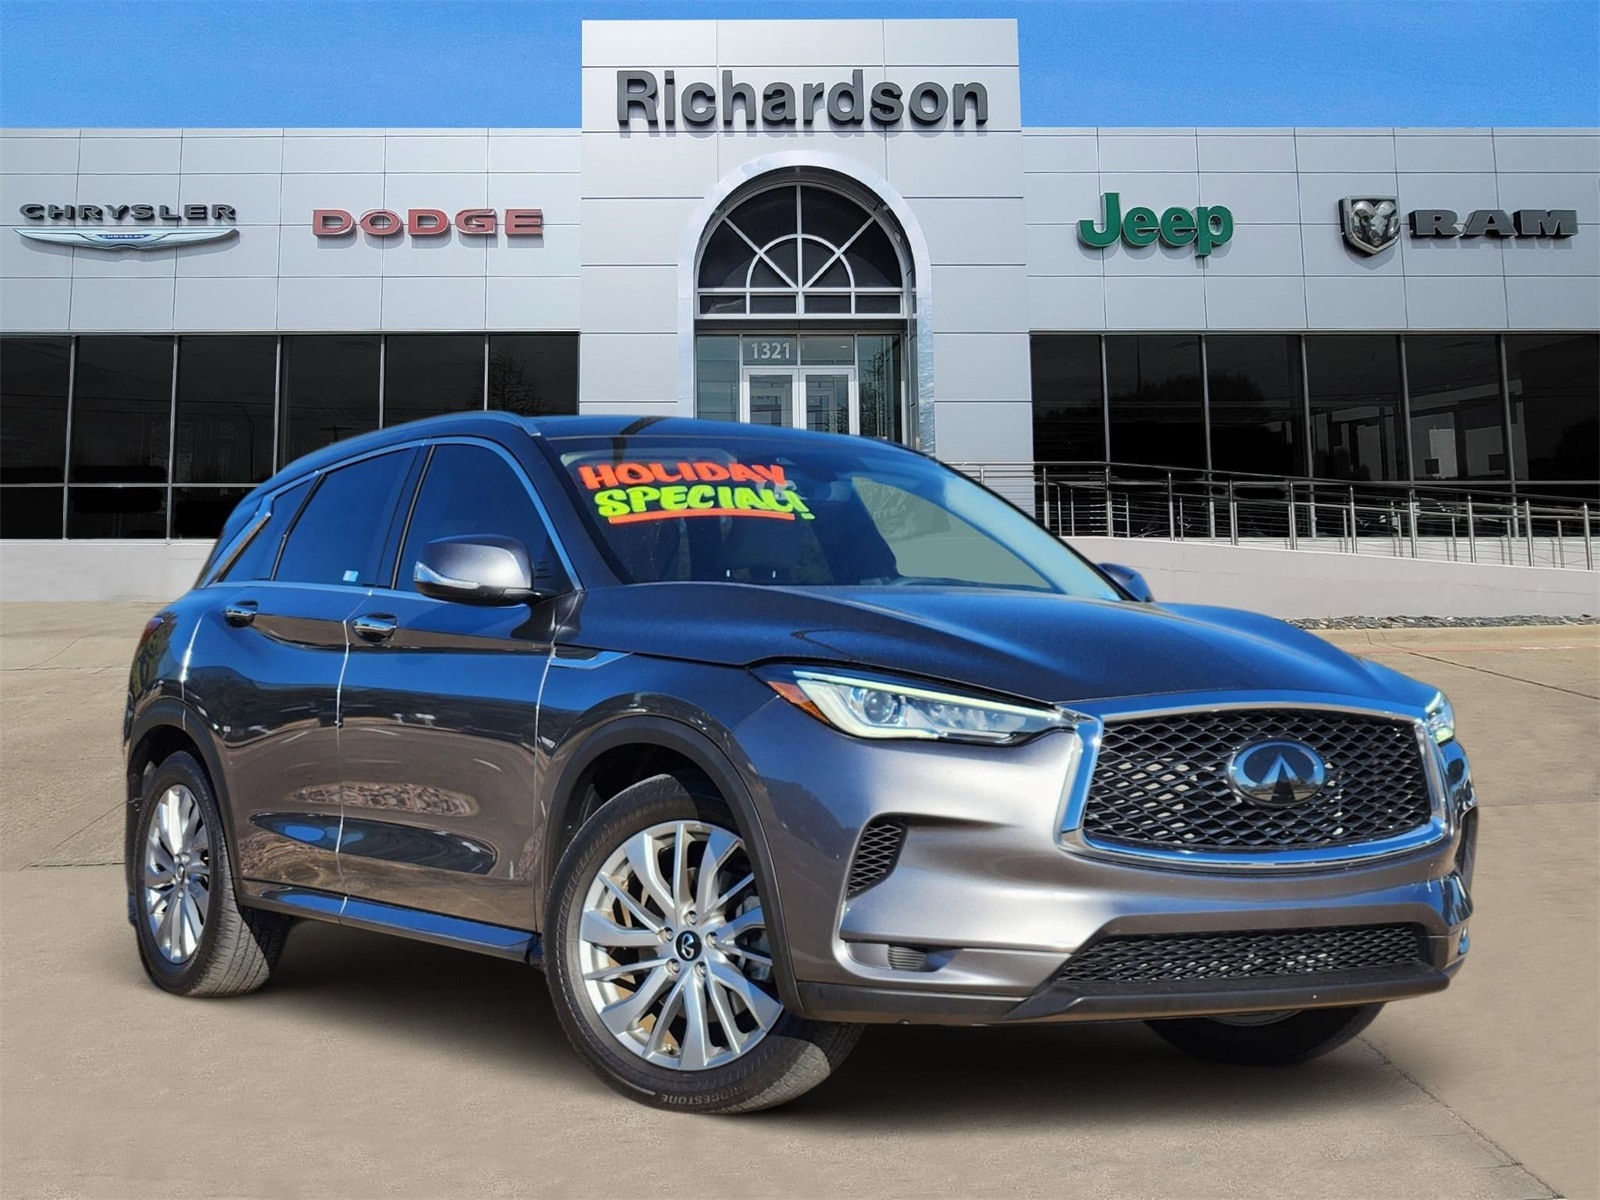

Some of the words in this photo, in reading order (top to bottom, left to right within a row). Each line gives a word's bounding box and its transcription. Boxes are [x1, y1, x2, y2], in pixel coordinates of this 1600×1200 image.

[616, 69, 988, 127] Richardson
[19, 203, 236, 221] CHRYSLER
[312, 208, 543, 236] DODGE
[1077, 192, 1234, 257] Jeep
[1408, 209, 1577, 239] RAM
[751, 342, 790, 359] 1321
[578, 461, 787, 490] HOLIDAY
[594, 484, 815, 519] SPECIAL!
